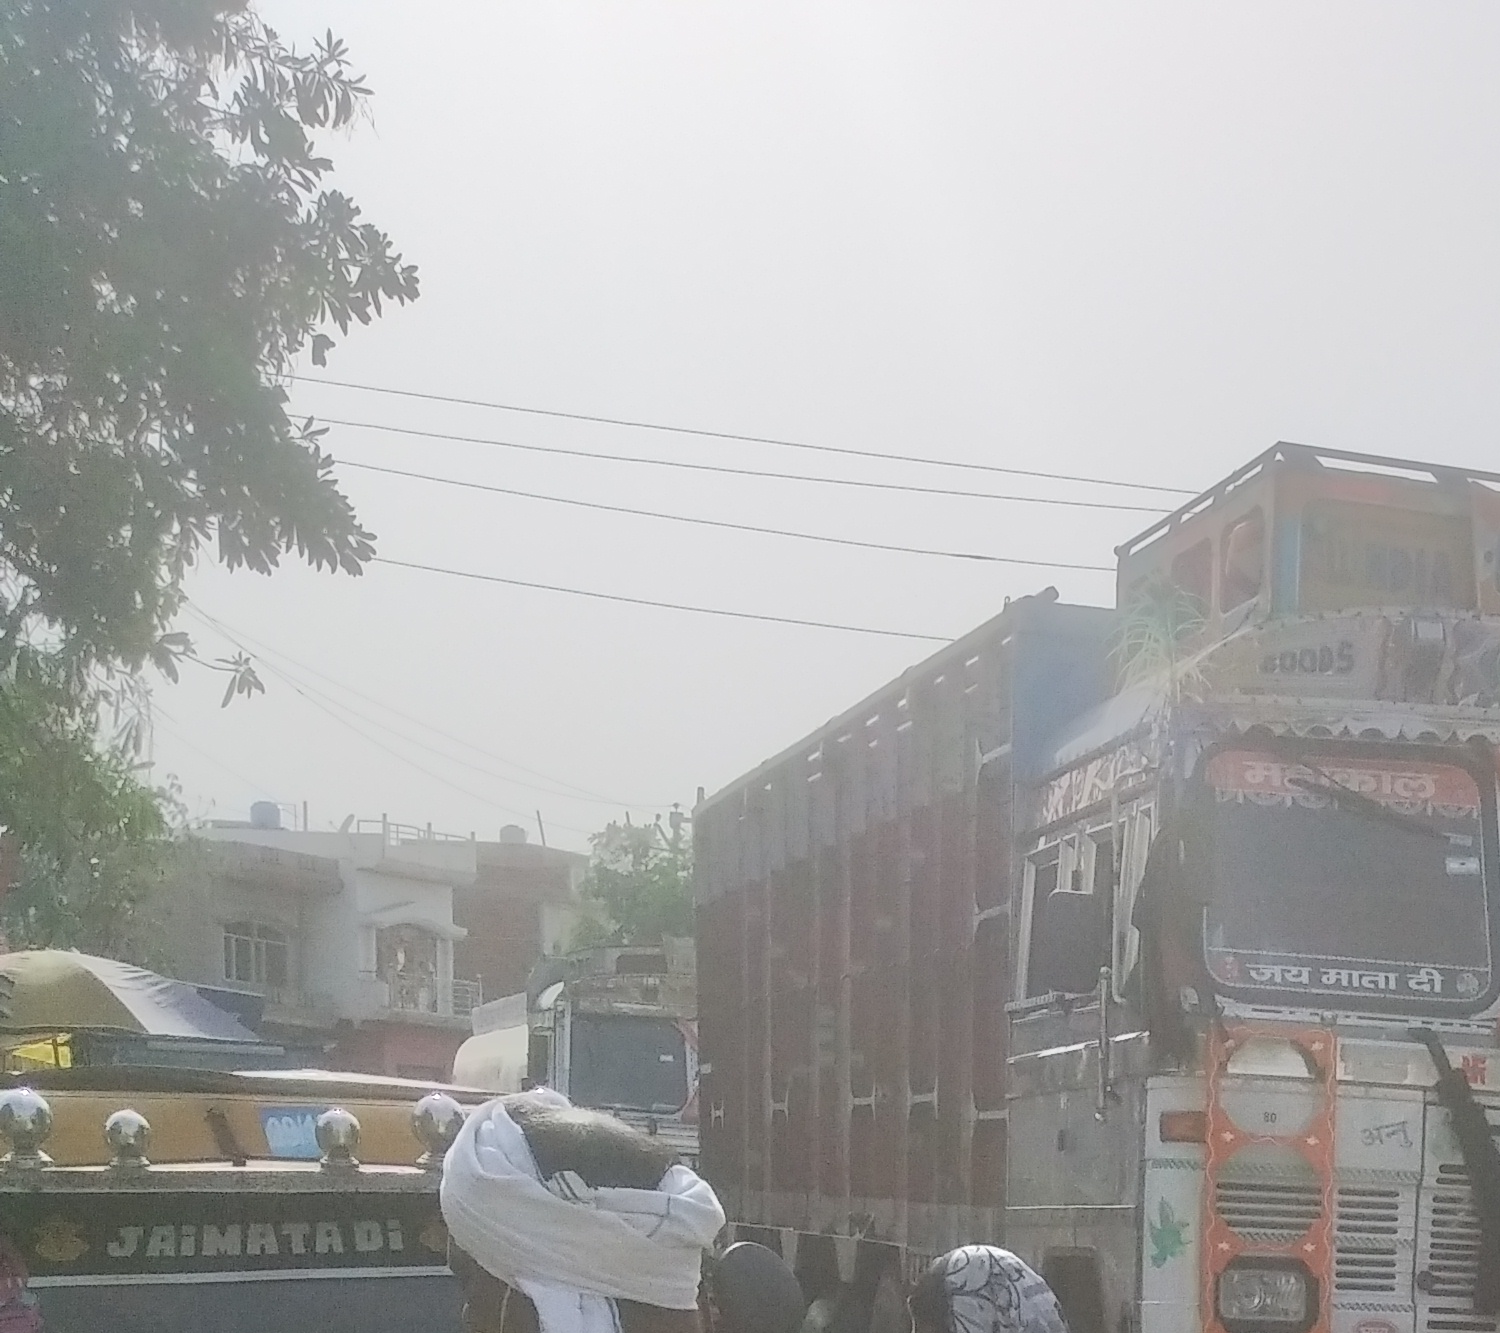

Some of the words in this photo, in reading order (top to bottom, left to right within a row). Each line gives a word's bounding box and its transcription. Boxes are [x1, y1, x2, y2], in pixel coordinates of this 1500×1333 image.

[1246, 963, 1312, 985] जय
[1320, 967, 1398, 991] माता
[1407, 967, 1445, 994] दी
[1263, 1111, 1278, 1124] 80
